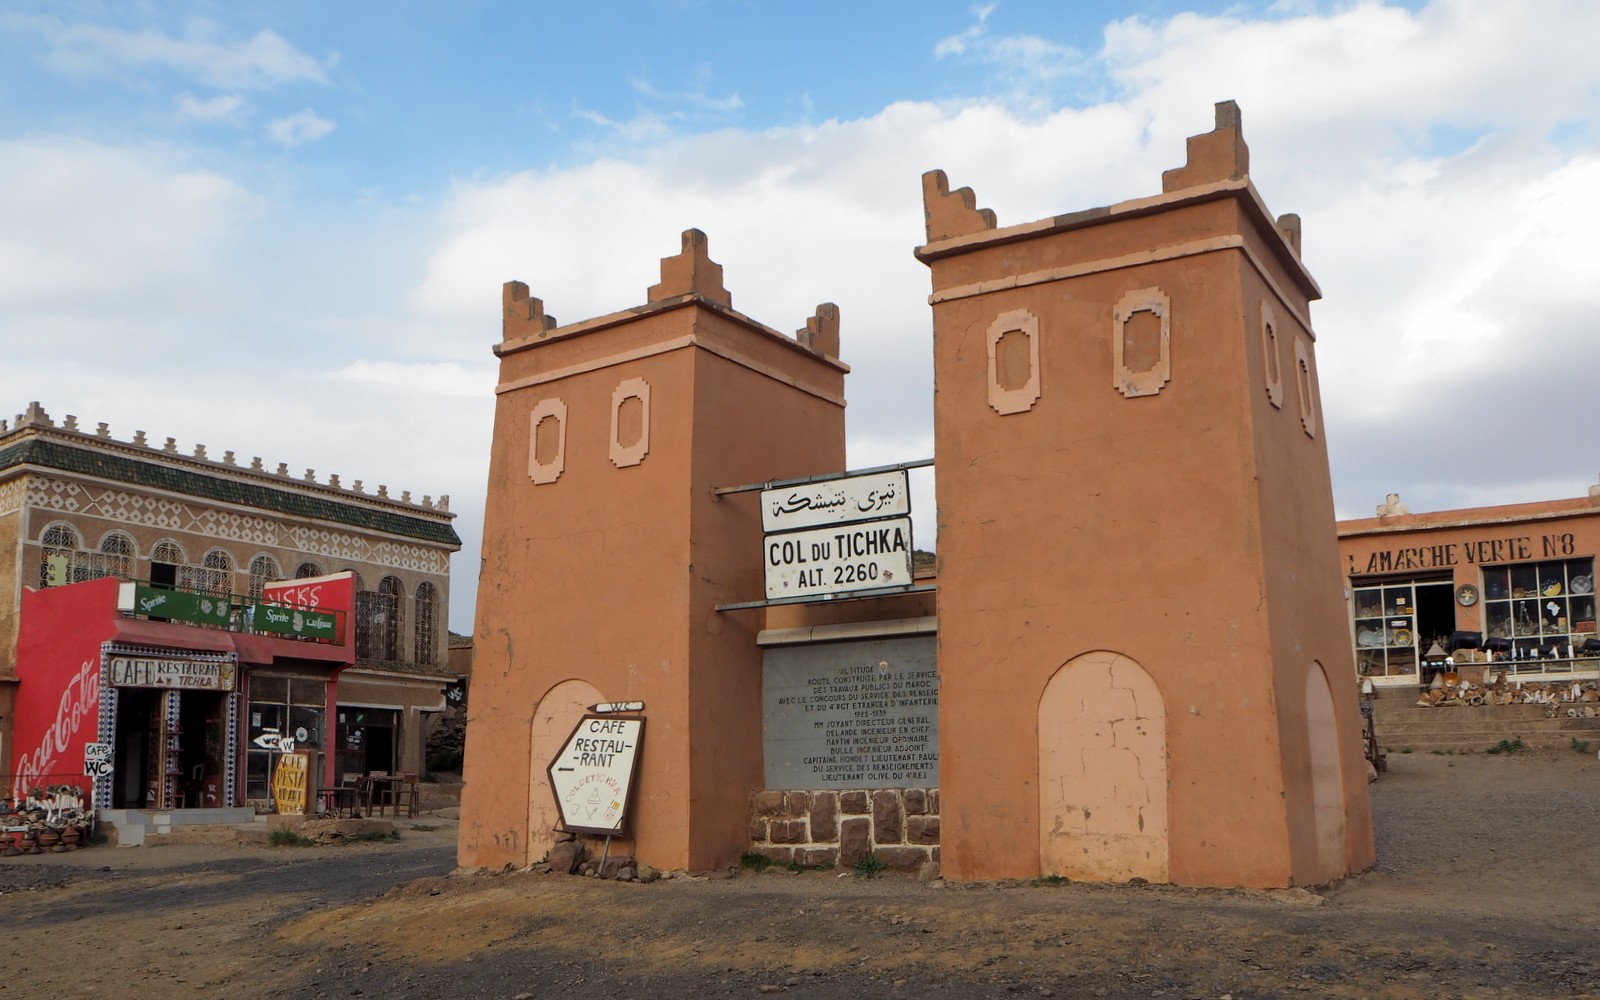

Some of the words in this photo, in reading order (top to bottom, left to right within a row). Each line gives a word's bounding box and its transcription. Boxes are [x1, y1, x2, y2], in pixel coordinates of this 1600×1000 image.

[769, 540, 806, 566] COL
[811, 542, 830, 562] DU
[834, 528, 906, 559] TICHKA
[1464, 537, 1532, 563] VERTE
[798, 569, 827, 588] ALT.
[833, 562, 878, 584] 2260
[140, 592, 167, 611] Sprite
[266, 609, 290, 623] Sprite
[112, 659, 155, 684] CAFE
[833, 675, 875, 684] CONSTRUITE
[879, 673, 891, 681] PAR
[908, 671, 937, 679] SERVICE
[813, 686, 827, 694] DES
[830, 685, 858, 693] TRAVAUX
[861, 683, 889, 691] PUBLICS
[906, 680, 931, 688] MAROC
[778, 697, 796, 705] AVEC
[797, 696, 807, 704] LE
[810, 695, 846, 703] CONCOURS
[861, 692, 890, 700] SERVICE
[610, 702, 630, 711] WC
[852, 701, 888, 710] ETRANGER
[589, 720, 626, 734] CAFE
[855, 719, 895, 727] DIRECTEUR
[897, 716, 930, 725] GENERAL
[13, 657, 100, 808] Coca-Cola
[899, 726, 908, 734] EN
[826, 738, 850, 746] MARTIN
[892, 735, 930, 744] ORDINAIRE
[895, 744, 925, 752] ADJOINT
[803, 756, 837, 764] CAPITAINE
[871, 753, 915, 762] LIEUTENANT
[85, 761, 107, 777] WC
[813, 765, 823, 773] DU
[826, 764, 854, 772] SERVICE
[872, 762, 934, 771] RENSEIGNEMENTS
[821, 773, 864, 781] LIEUTENANT
[867, 772, 889, 780] OLIVE
[892, 772, 903, 780] DU
